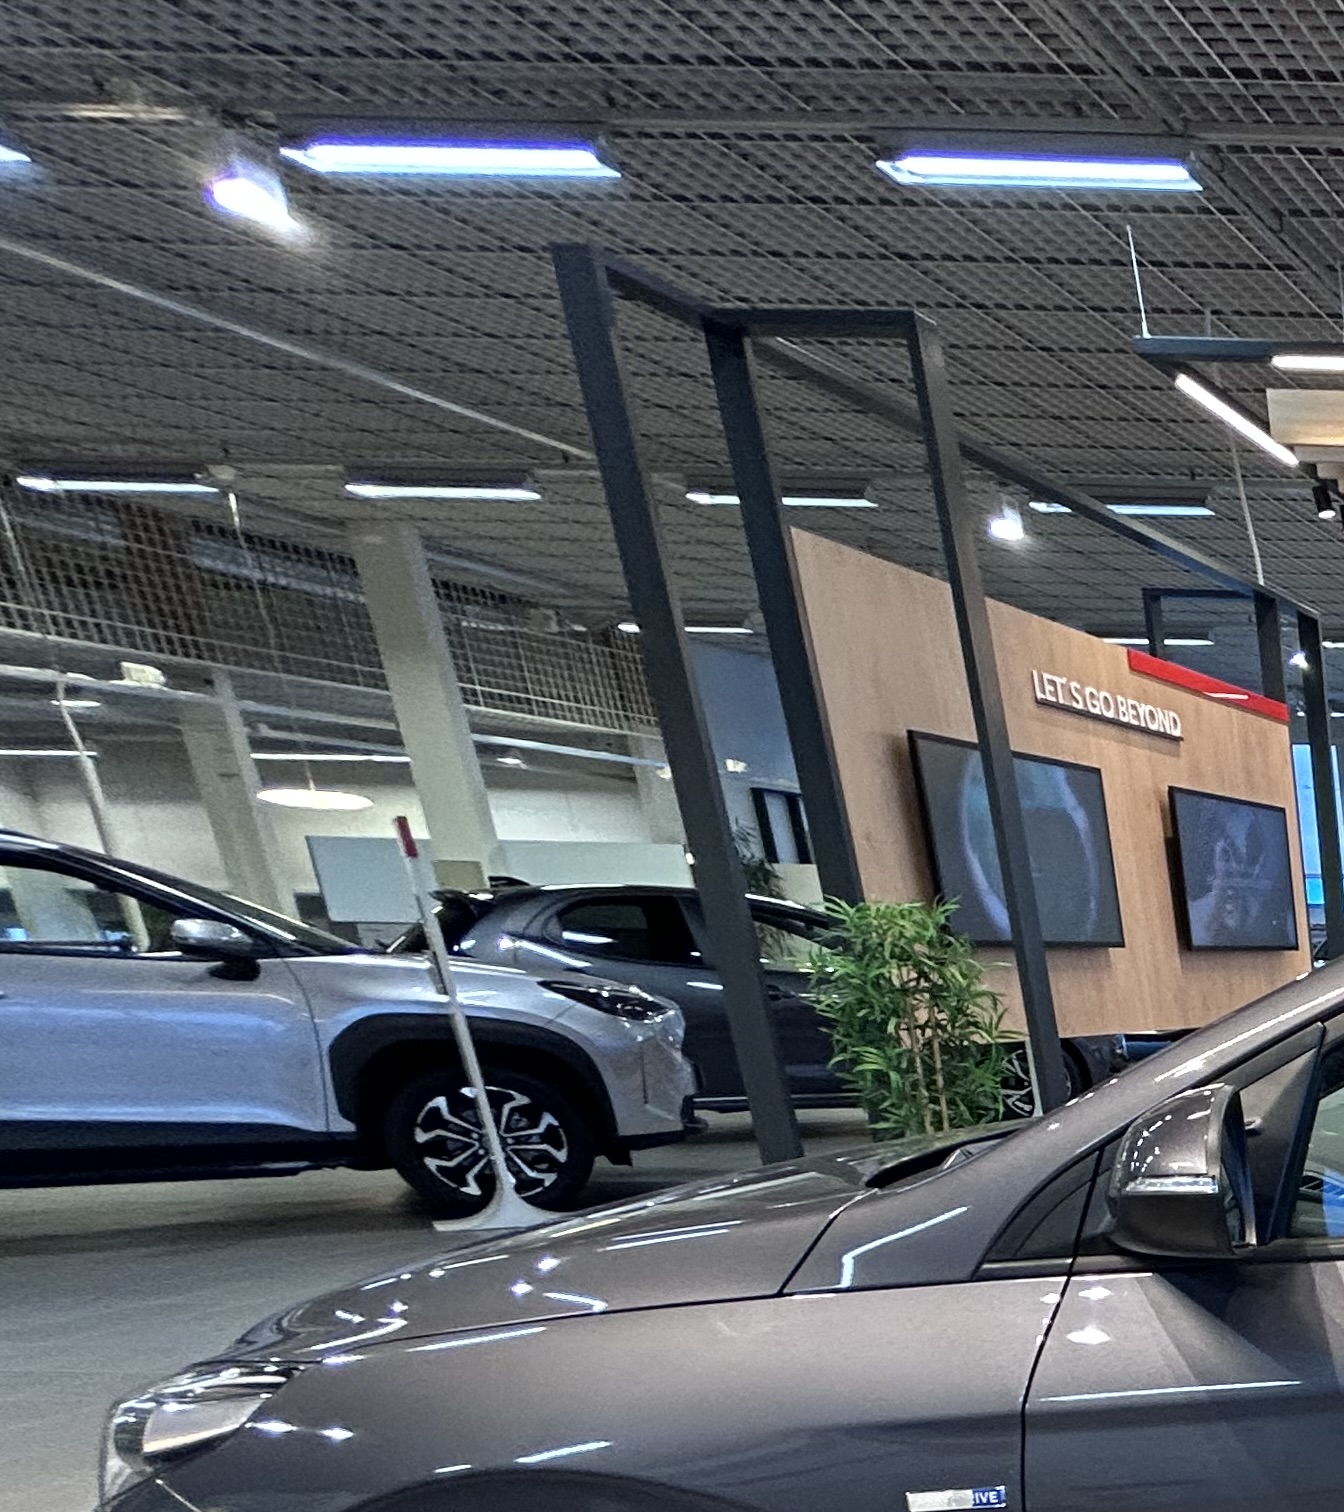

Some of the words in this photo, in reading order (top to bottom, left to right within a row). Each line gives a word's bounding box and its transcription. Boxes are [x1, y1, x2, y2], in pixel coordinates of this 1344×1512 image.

[1032, 669, 1084, 710] LET'S
[1085, 686, 1115, 719] GO
[1117, 694, 1182, 737] BEYOND
